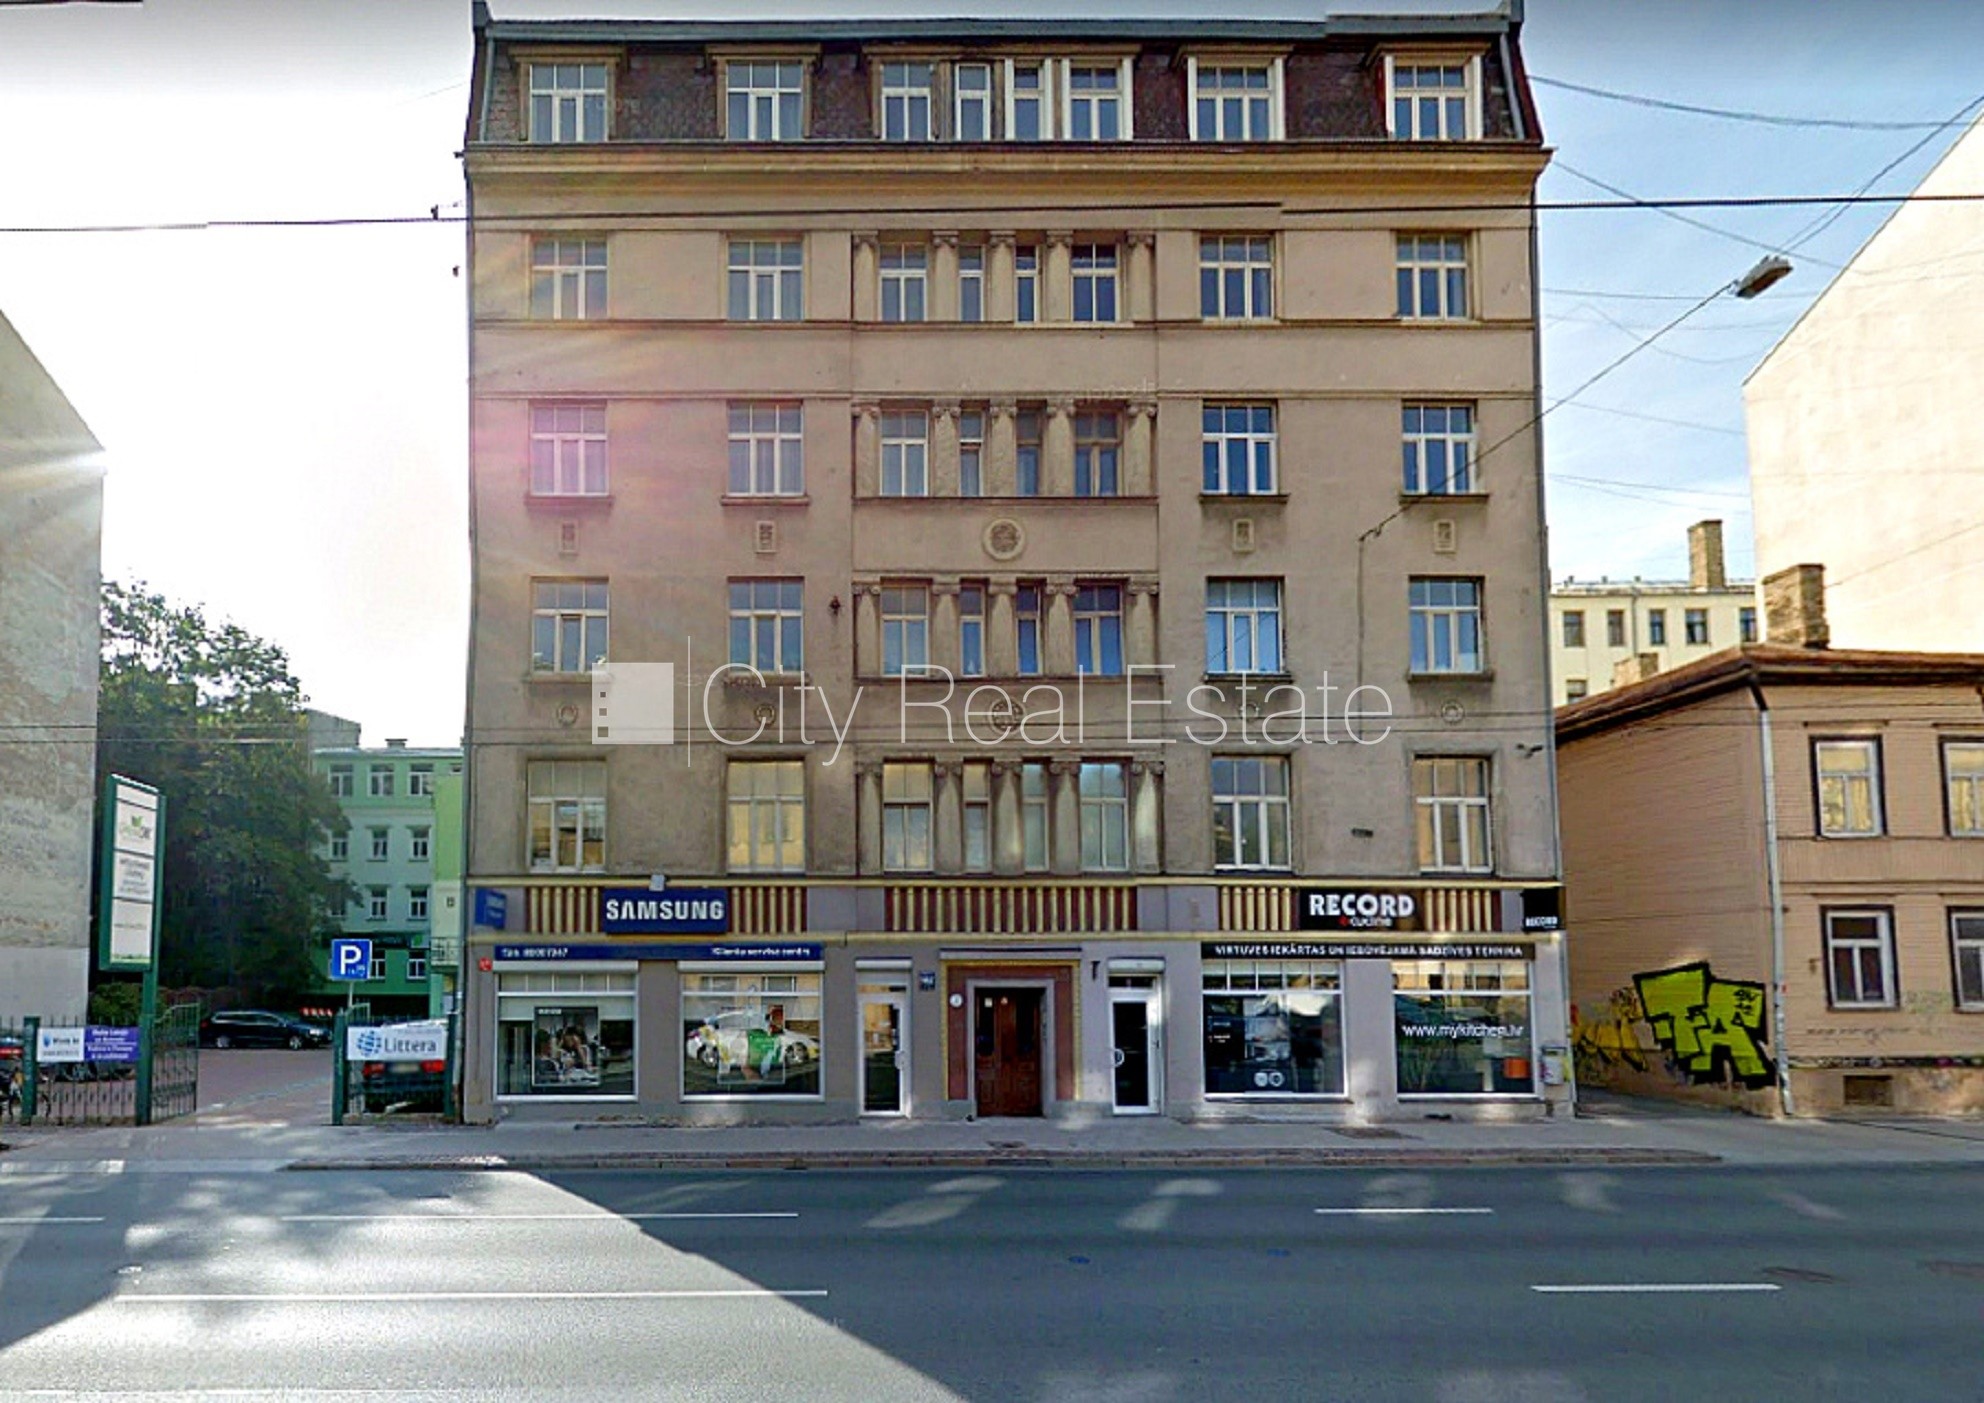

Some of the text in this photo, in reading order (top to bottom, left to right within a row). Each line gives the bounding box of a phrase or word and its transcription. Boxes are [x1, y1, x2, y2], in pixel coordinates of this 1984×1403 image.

[606, 898, 724, 920] SAMSUNG
[1309, 893, 1414, 917] RECORD
[340, 945, 362, 975] P
[384, 1037, 437, 1054] Littera
